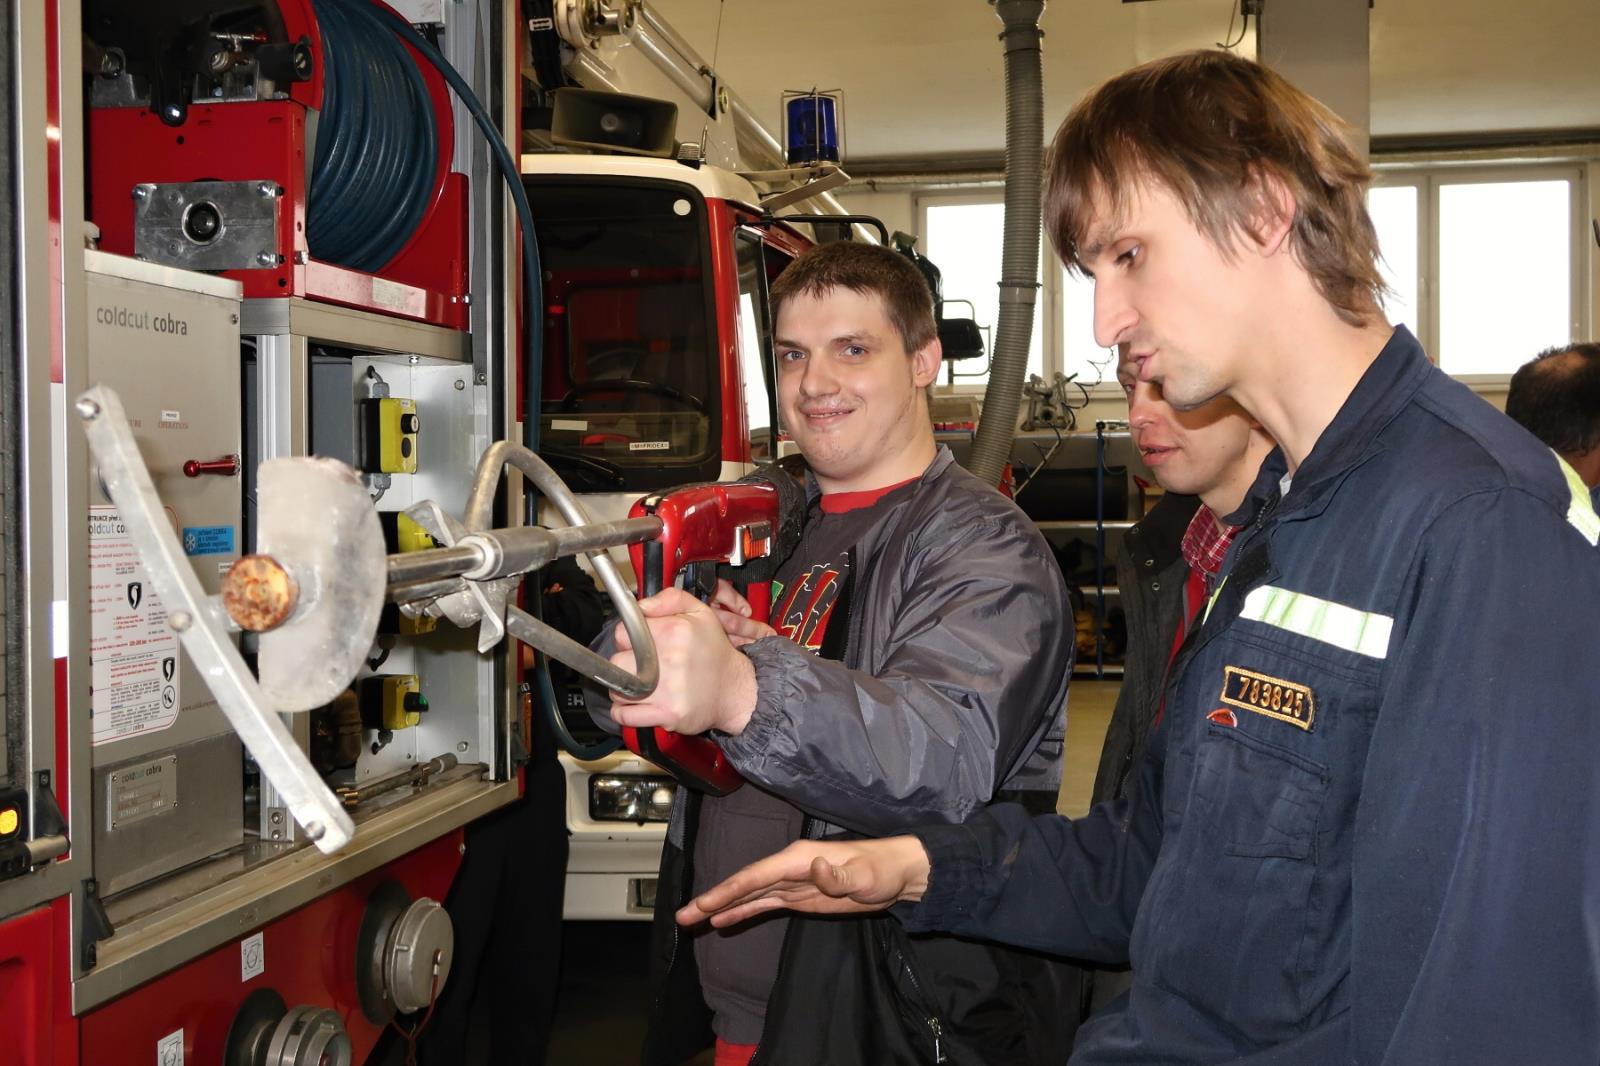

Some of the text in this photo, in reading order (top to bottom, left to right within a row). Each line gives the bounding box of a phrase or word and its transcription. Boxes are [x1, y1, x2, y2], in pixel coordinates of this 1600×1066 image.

[96, 305, 188, 336] coldcut cobra
[88, 522, 128, 535] oldcut co
[1237, 676, 1303, 718] 783825
